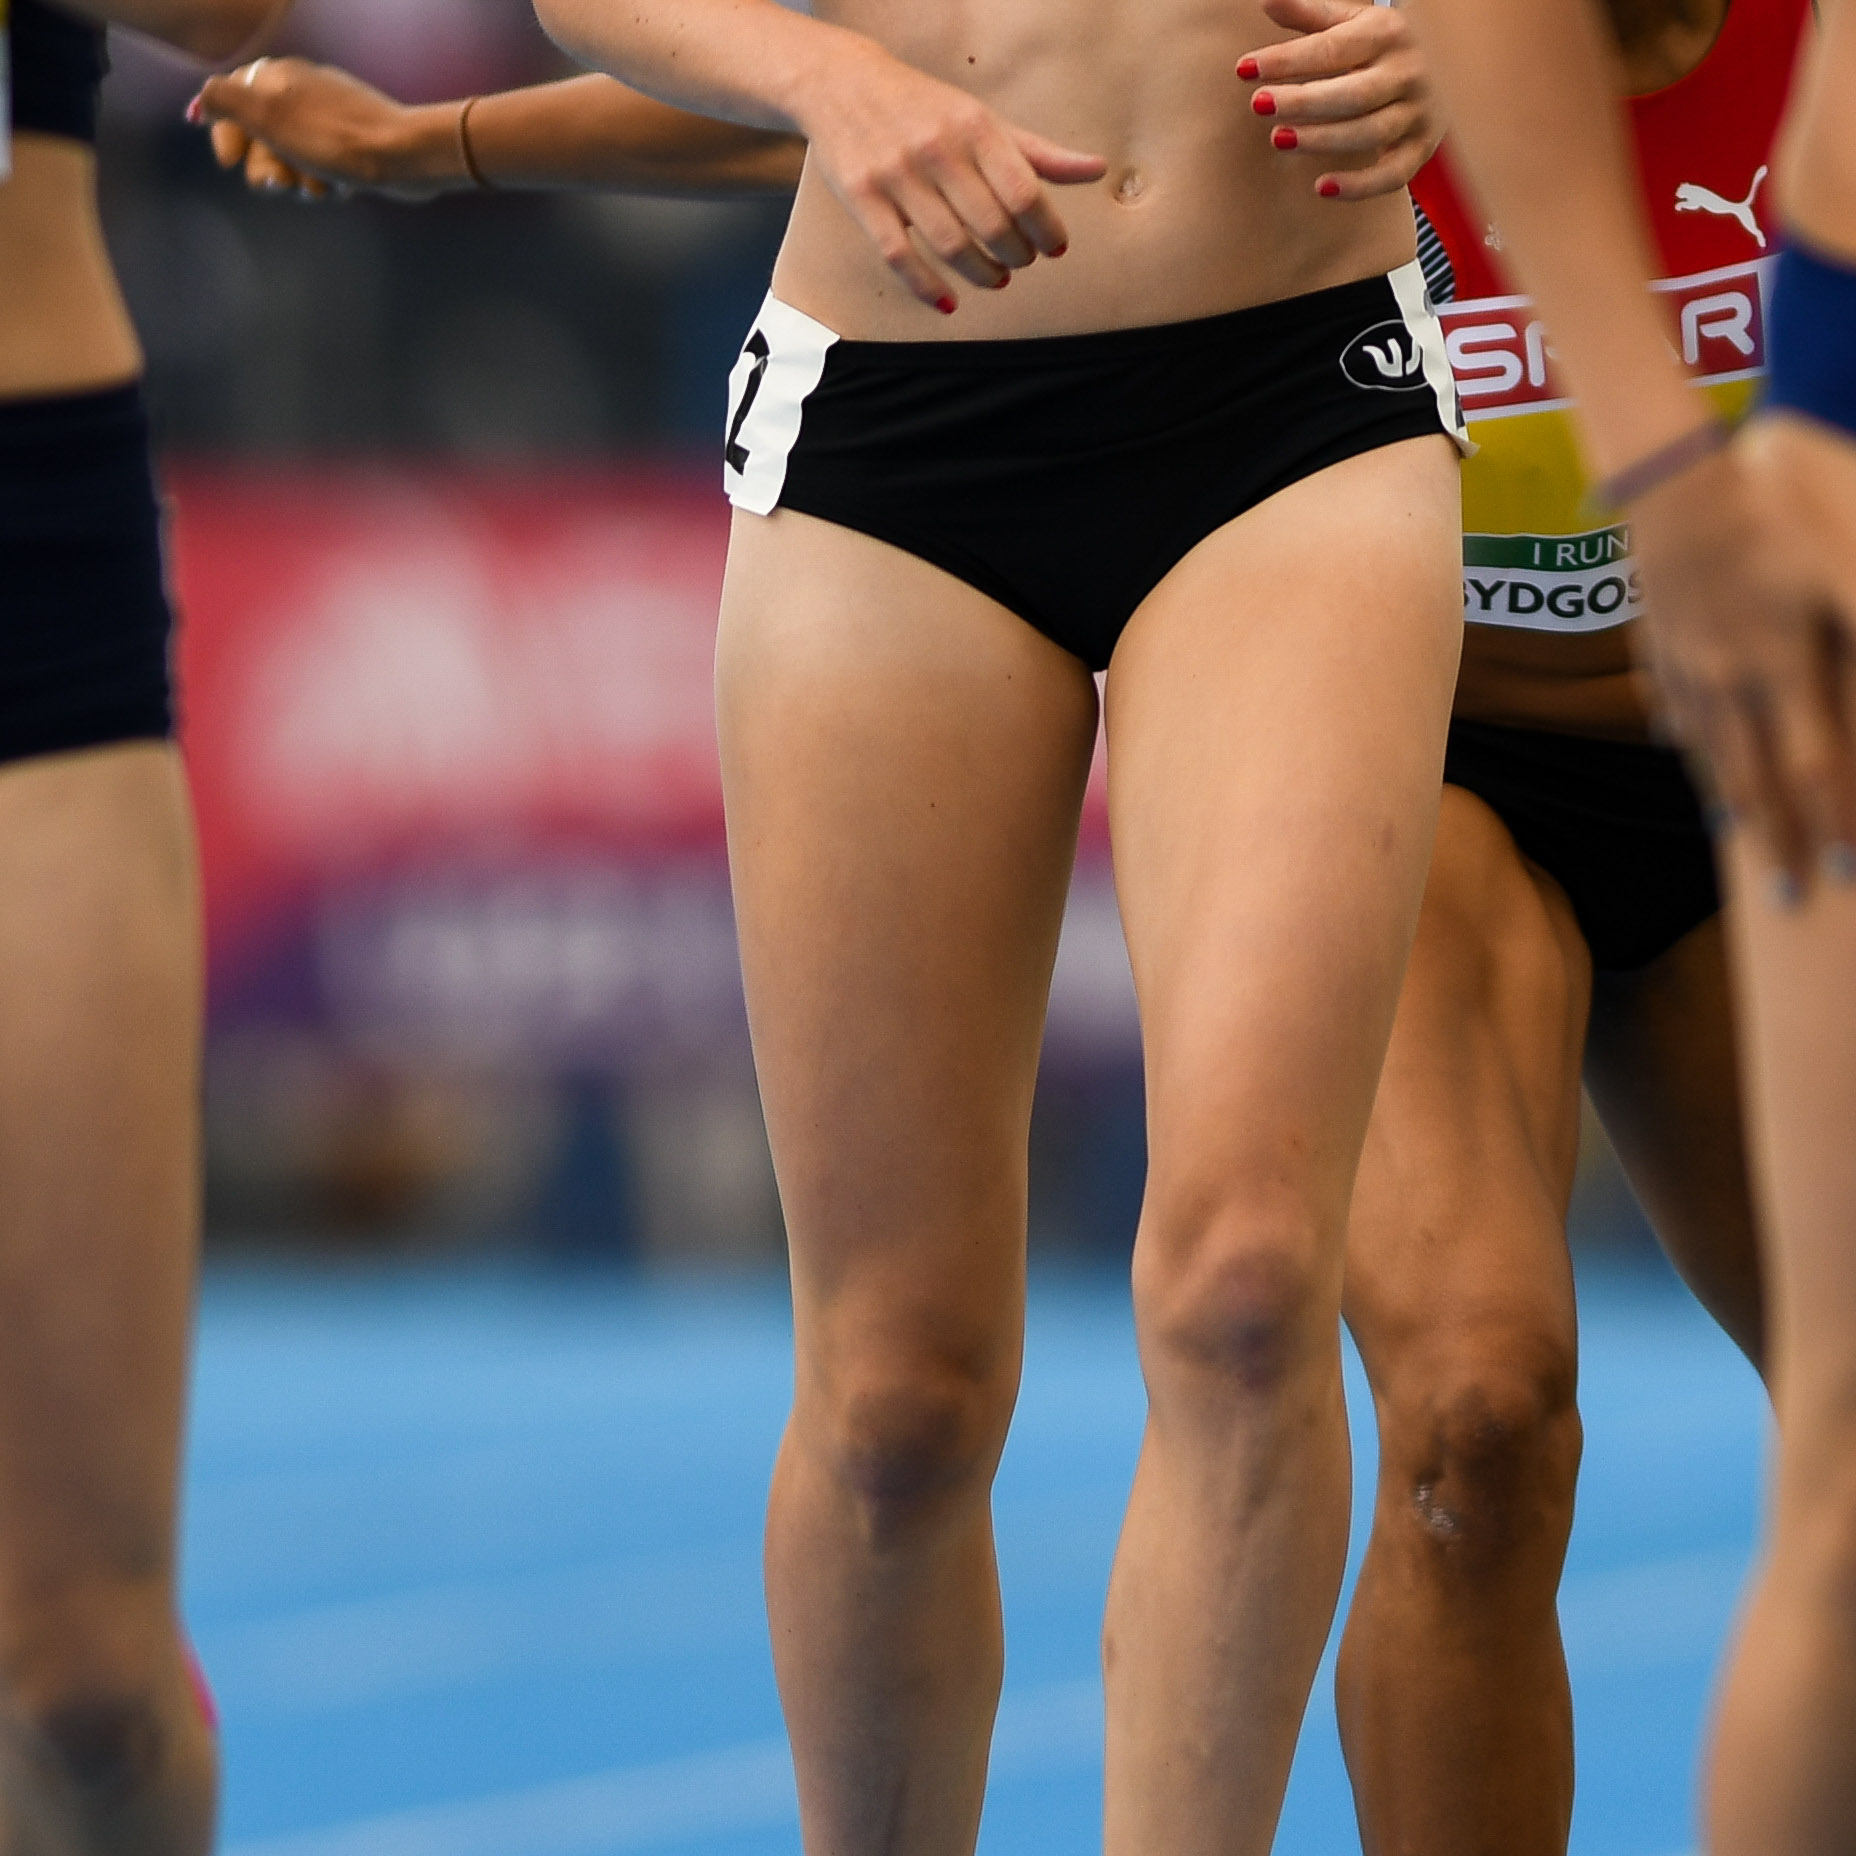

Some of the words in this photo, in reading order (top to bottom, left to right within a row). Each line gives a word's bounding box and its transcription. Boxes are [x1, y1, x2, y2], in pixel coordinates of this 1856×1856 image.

[1445, 291, 1756, 398] SR
[1555, 529, 1630, 567] RUN
[1462, 572, 1642, 619] YDGO
